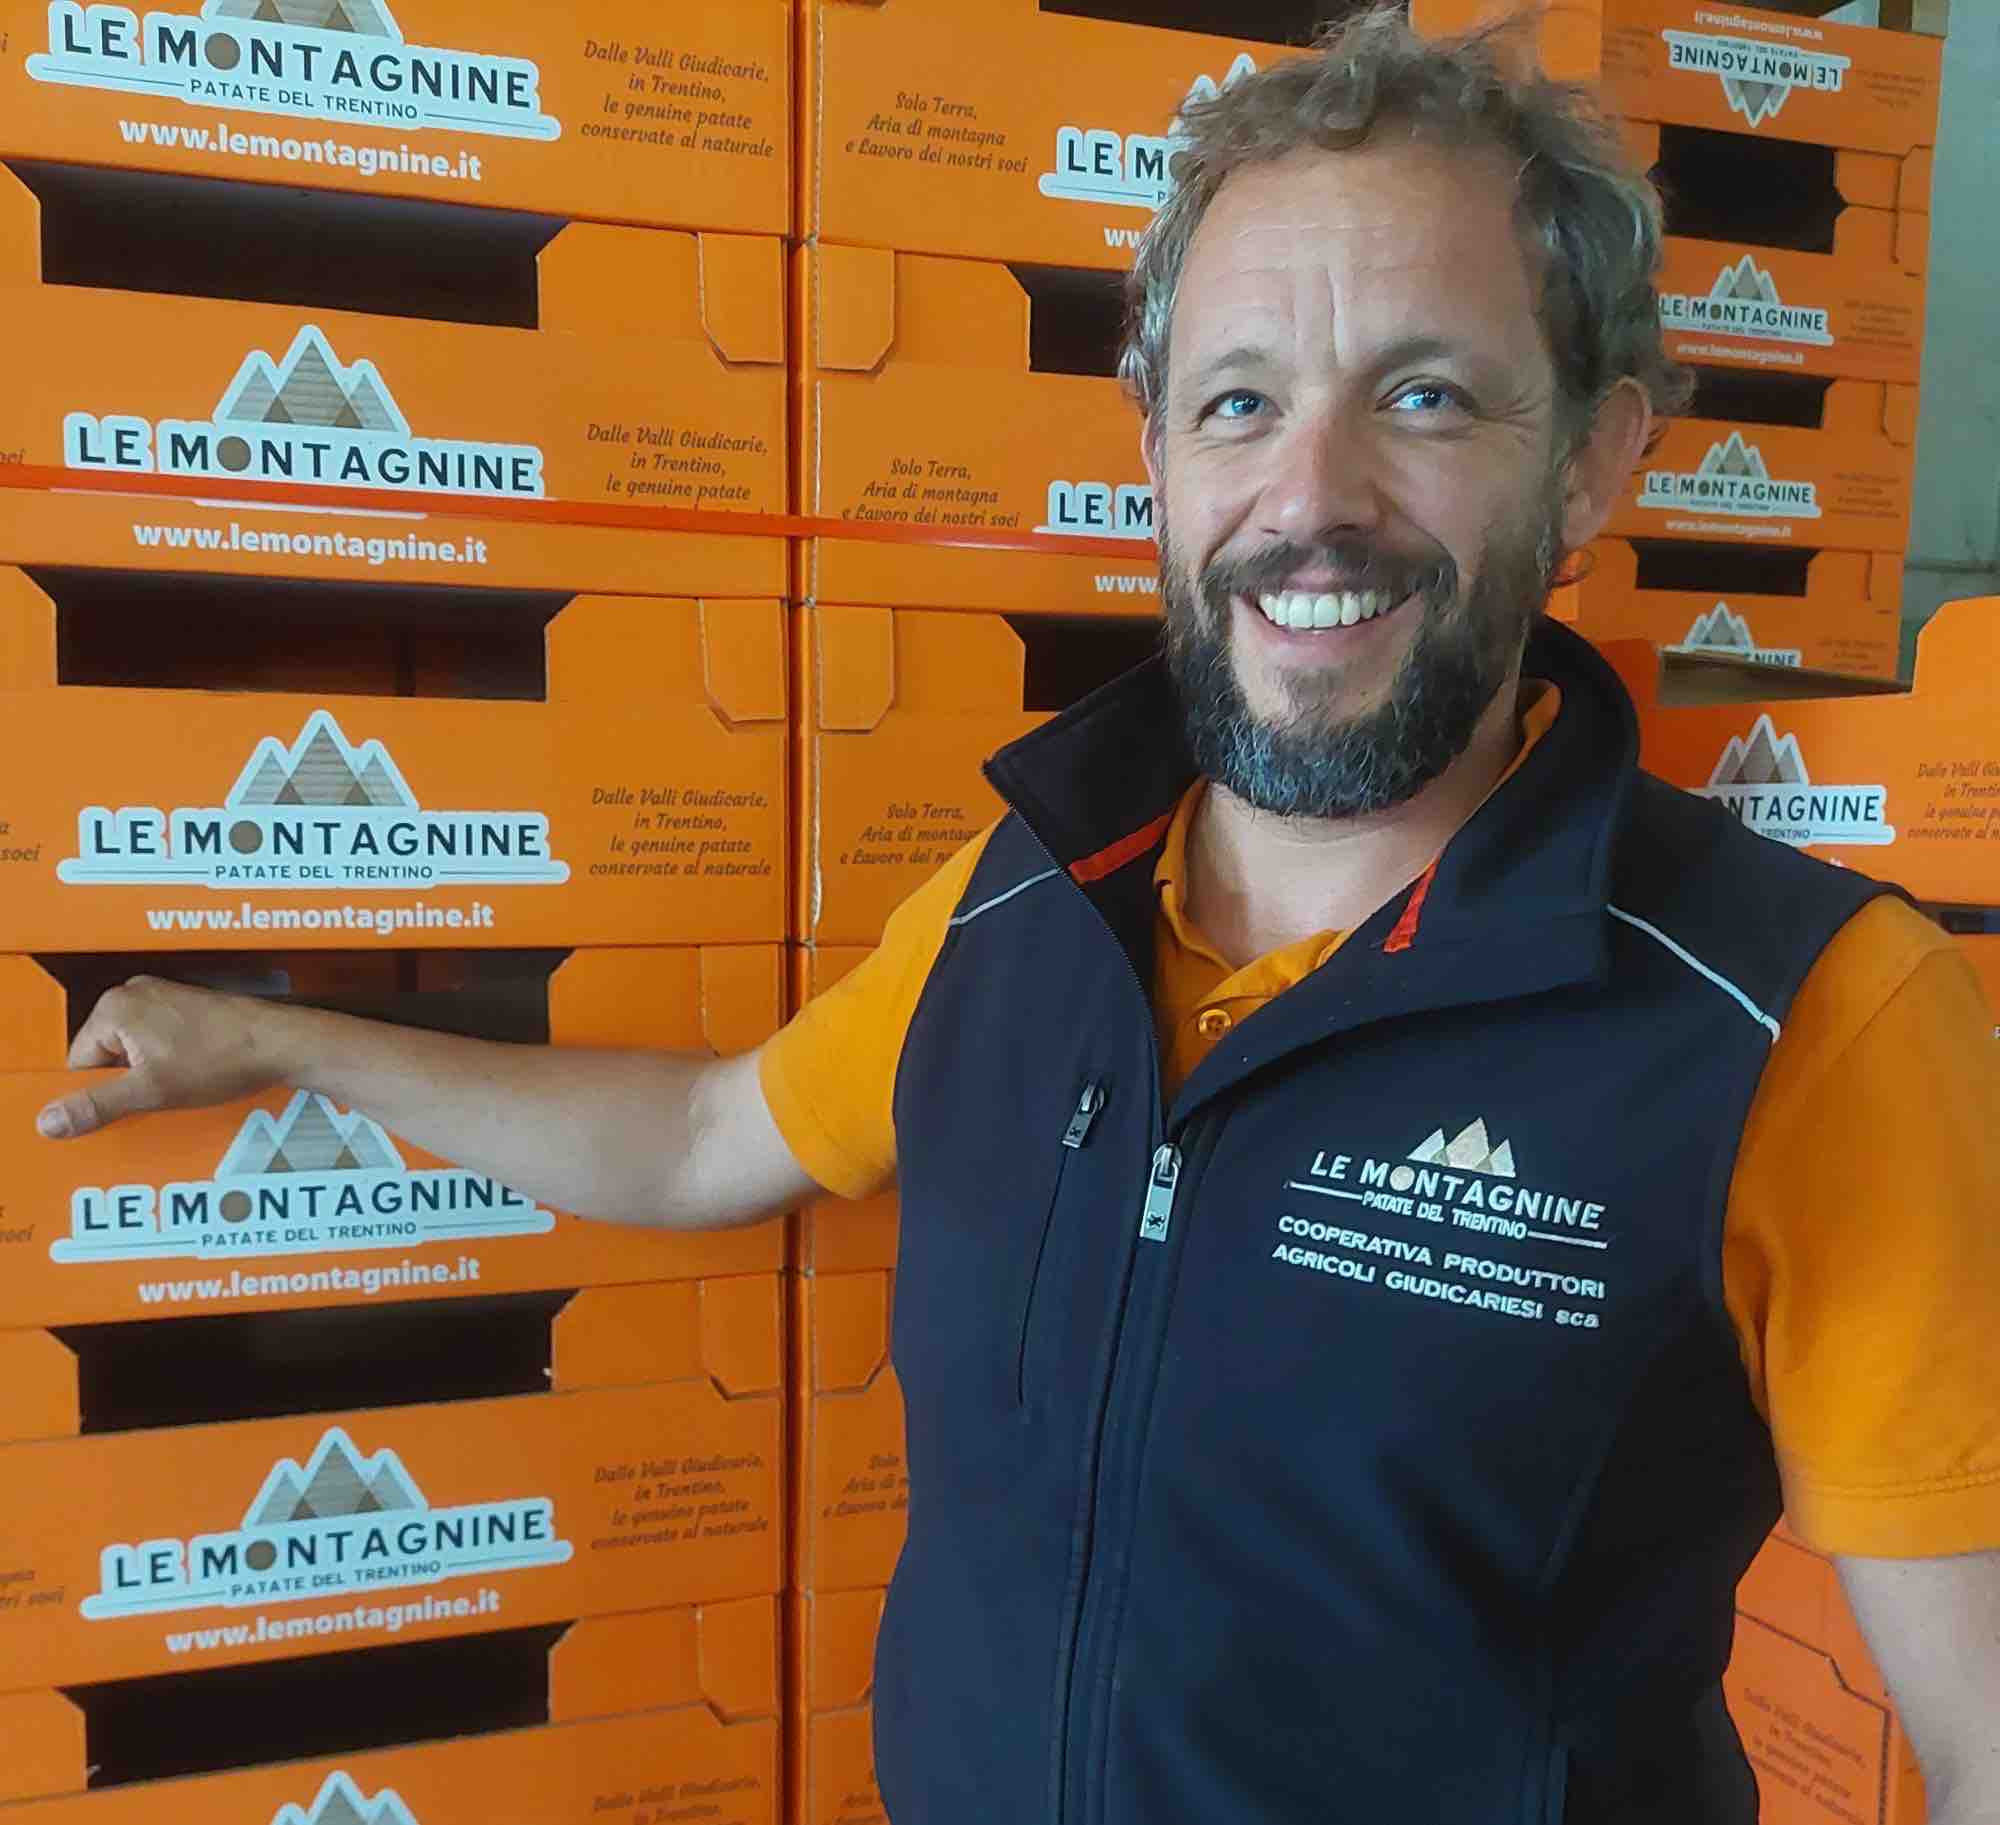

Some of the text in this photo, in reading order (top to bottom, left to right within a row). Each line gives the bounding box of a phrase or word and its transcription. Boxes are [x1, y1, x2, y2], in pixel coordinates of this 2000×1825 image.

[64, 14, 530, 108] LE MONTAGNINE
[583, 40, 769, 82] Dalle Valli Giudicarie,
[1816, 66, 1838, 86] LE
[191, 79, 418, 119] PATATE DEL TRENTINO
[629, 73, 726, 103] in Trentino,
[603, 93, 753, 129] le genuine patate
[581, 123, 774, 157] conservate al naturale
[867, 113, 1006, 147] Aria di montagna
[119, 119, 482, 181] www.lemontagnine.it
[845, 142, 854, 152] e
[919, 144, 942, 163] dei
[947, 151, 992, 169] nostri
[998, 156, 1028, 173] soci
[1068, 140, 1113, 175] LE
[587, 424, 769, 455] Dalle Valli Giudicarie,
[79, 427, 535, 492] LE MONTAGNINE
[631, 452, 727, 476] in Trentino,
[891, 458, 972, 480] Solo Terra,
[606, 473, 751, 503] le genuine patate
[863, 480, 999, 506] Aria di montagna
[1649, 476, 1671, 493] LE
[842, 508, 851, 520] e
[914, 506, 937, 523] dei
[942, 509, 987, 526] nostri
[991, 512, 1021, 528] soci
[1060, 493, 1103, 524] LE
[133, 523, 487, 564] www.lemontagnine.it
[591, 786, 768, 808] Dalle Valli Giudicarie,
[1728, 796, 1879, 821] NTAGNINE
[94, 820, 541, 856] LE MONTAGNINE
[634, 812, 727, 832] in Trentino,
[859, 825, 892, 841] Aria
[897, 825, 912, 841] di
[609, 834, 752, 858] le genuine patate
[215, 865, 433, 879] PATATE DEL TRENTINO
[589, 858, 771, 876] conservate al naturale
[146, 902, 494, 935] www.lemontagnine.it
[1311, 1151, 1606, 1230] LE MONTAGNINE
[84, 1196, 143, 1230] LE
[1362, 1190, 1528, 1240] PATATE DEL TRENTINO
[202, 1222, 417, 1247] PATATE DEL TRENTINO
[1278, 1215, 1606, 1299] COOPERATIVA PRODUTTORI
[138, 1256, 480, 1303] www.lemontagnine.it
[1272, 1244, 1600, 1329] AGRICOLI GIUDICARIESI sca
[116, 1510, 546, 1587] LE MONTAGNINE
[232, 1560, 441, 1597] PATATE DEL TRENTINO
[166, 1588, 500, 1653] www.lemontagnine.it
